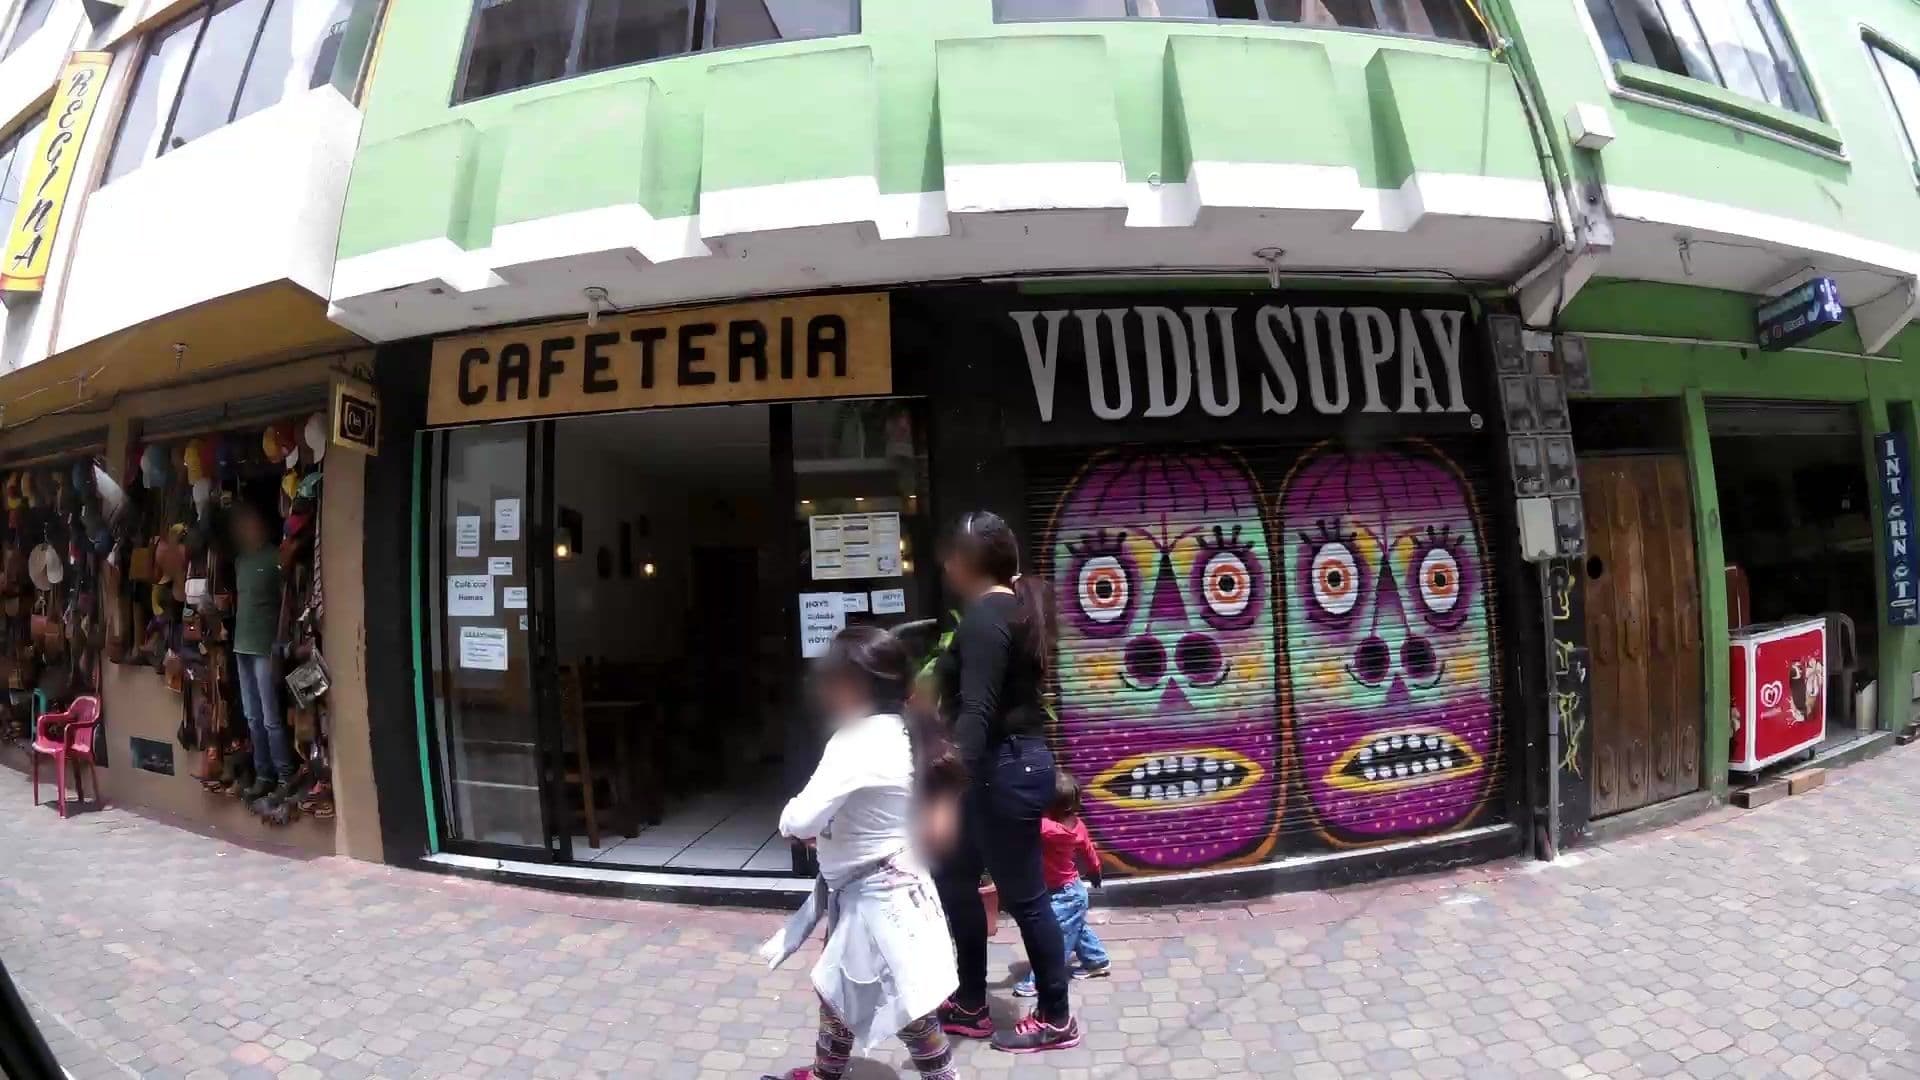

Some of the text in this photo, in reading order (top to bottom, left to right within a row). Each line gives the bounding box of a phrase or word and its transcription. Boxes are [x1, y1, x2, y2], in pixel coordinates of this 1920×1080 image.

[12, 69, 94, 270] REGINA
[458, 313, 848, 406] CAFETERIA
[1008, 303, 1471, 422] VUDU SUPAY
